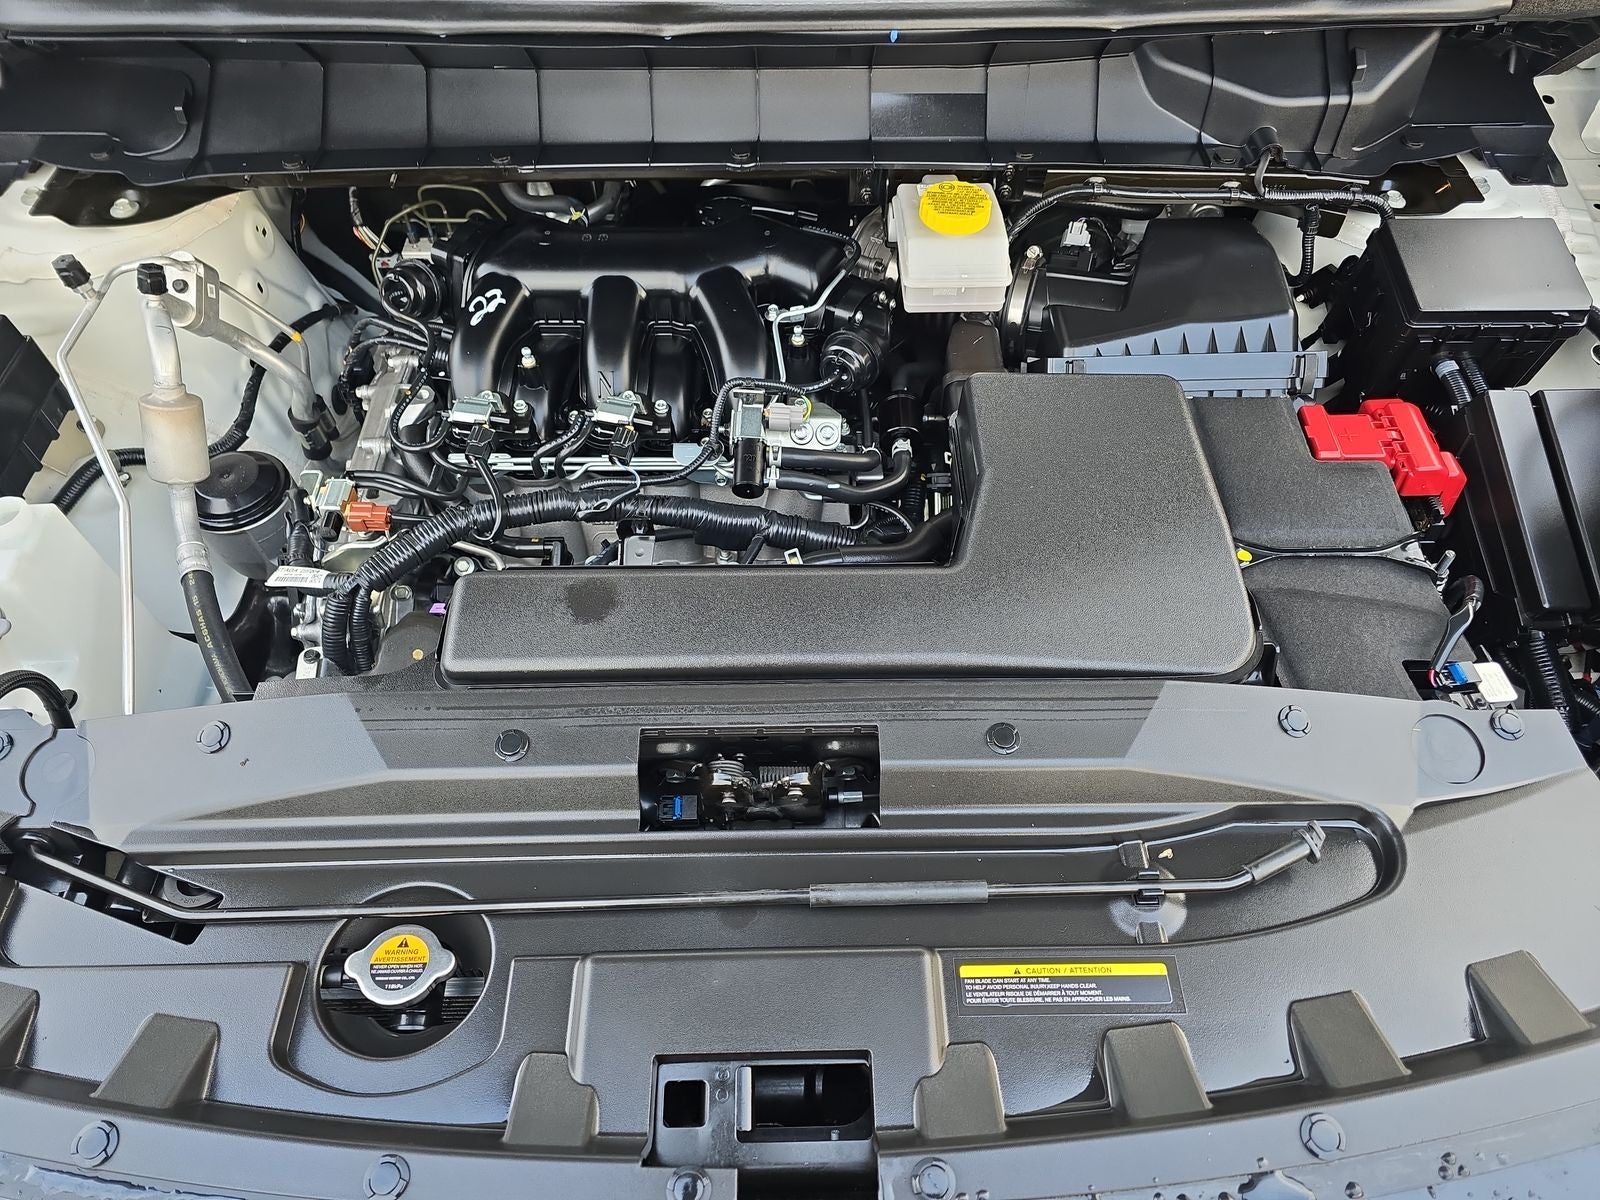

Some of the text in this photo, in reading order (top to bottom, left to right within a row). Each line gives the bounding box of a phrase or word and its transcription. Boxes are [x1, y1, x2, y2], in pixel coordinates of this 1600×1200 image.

[384, 948, 419, 956] WARNING
[373, 955, 426, 963] AVERTISSEMENT
[1026, 967, 1061, 975] CAUTION
